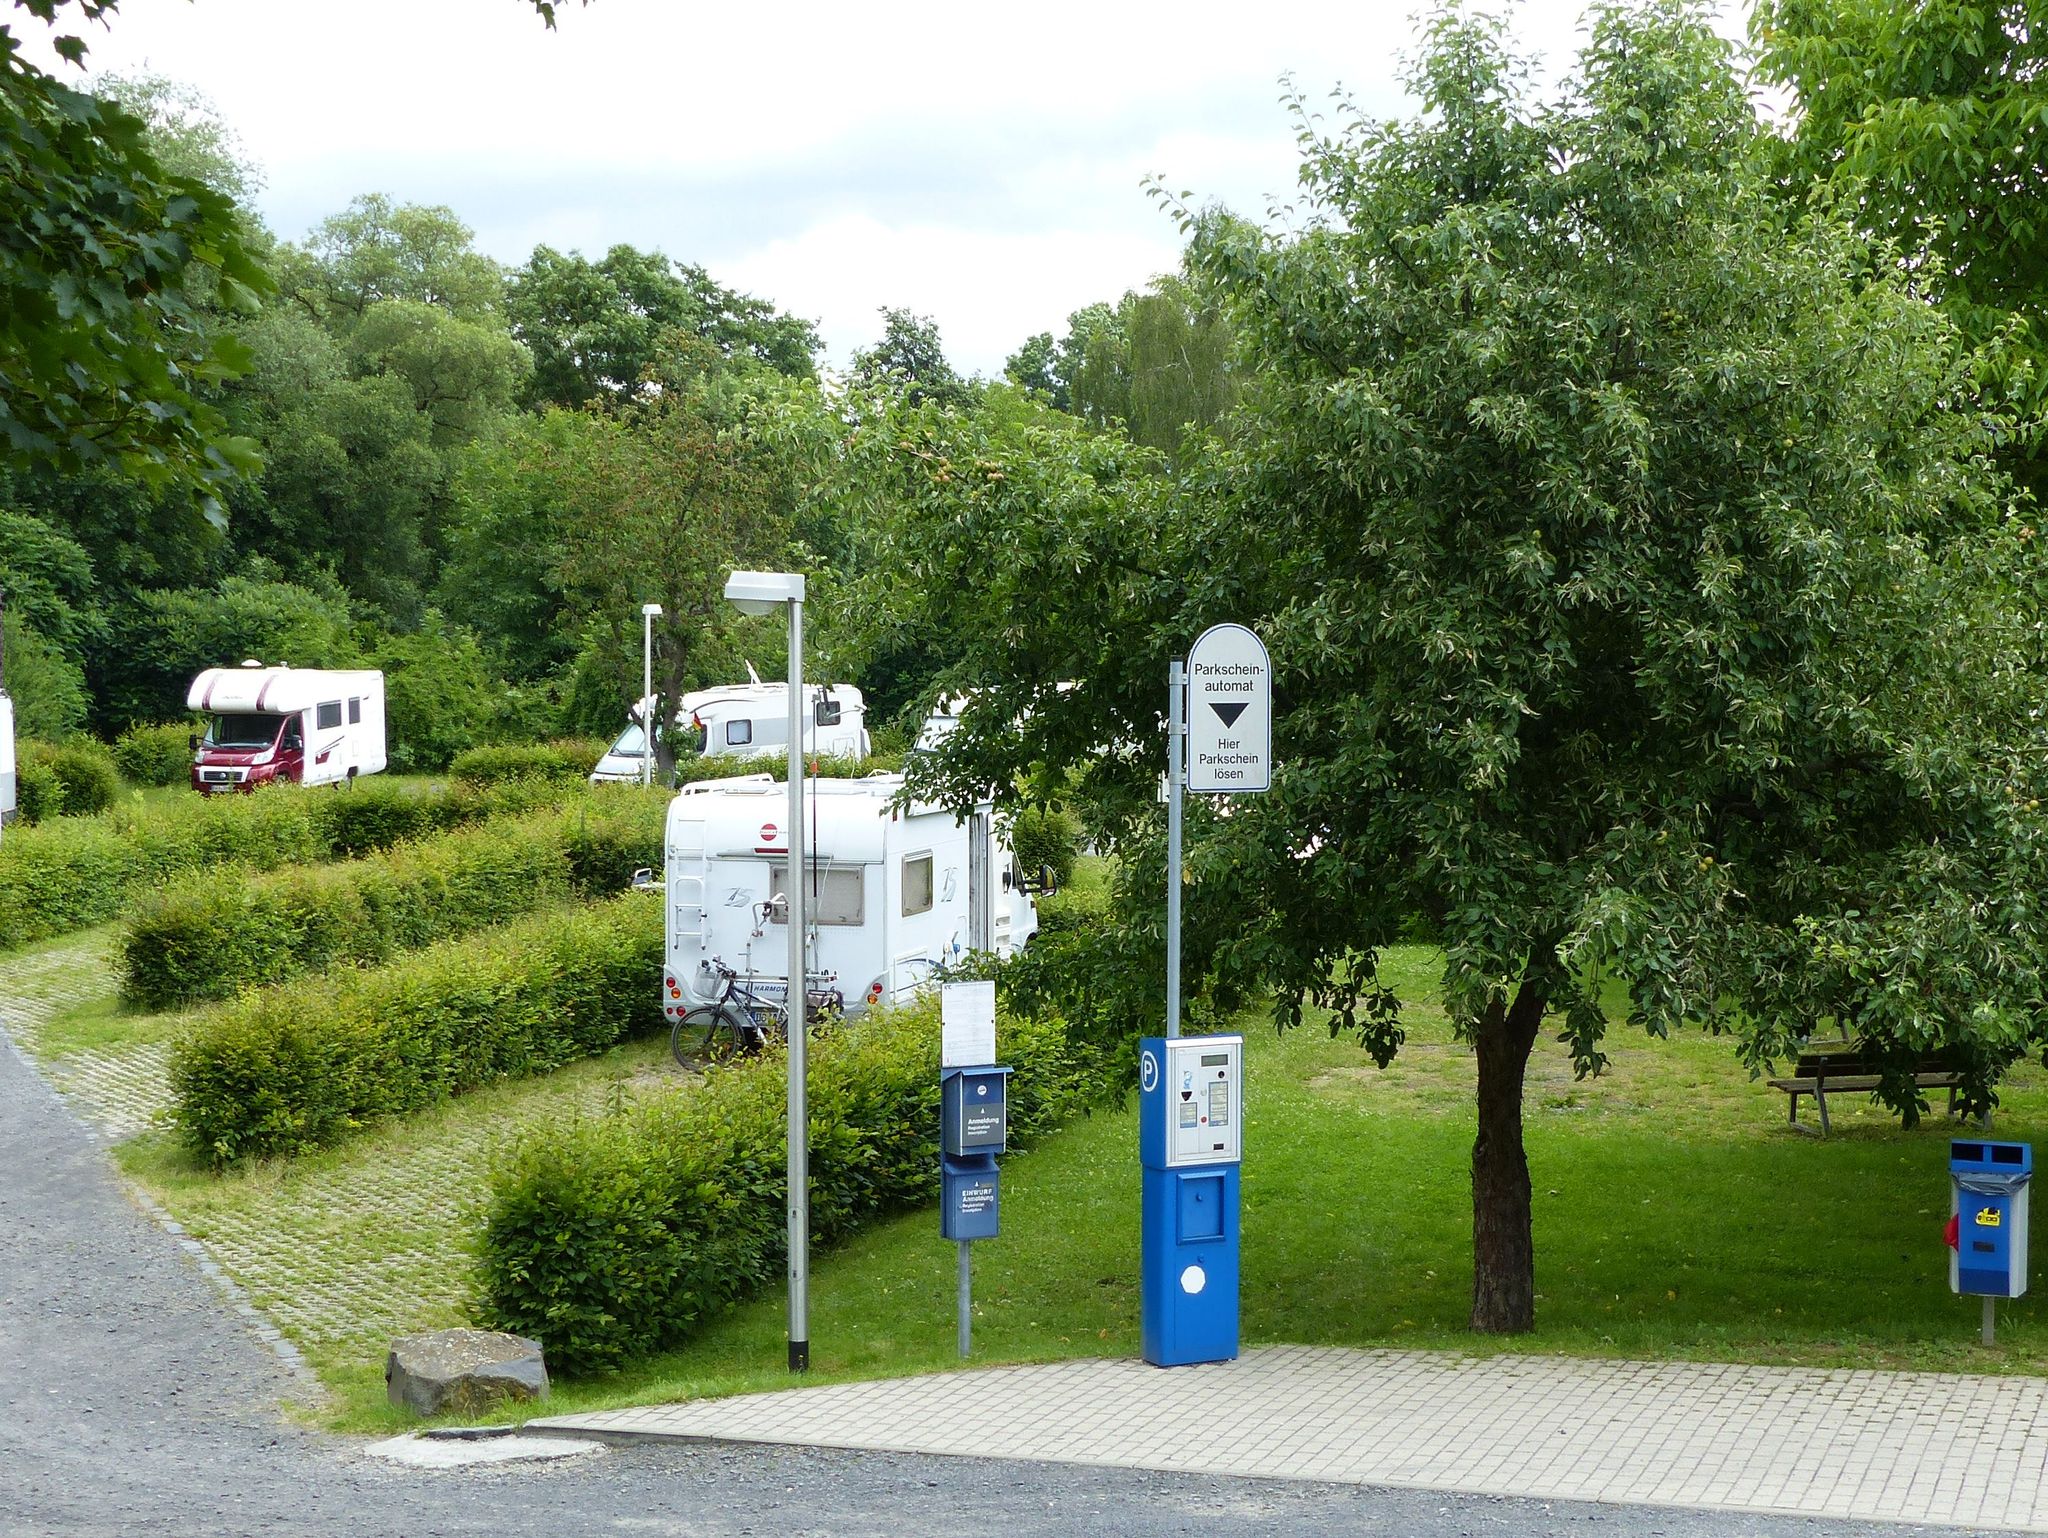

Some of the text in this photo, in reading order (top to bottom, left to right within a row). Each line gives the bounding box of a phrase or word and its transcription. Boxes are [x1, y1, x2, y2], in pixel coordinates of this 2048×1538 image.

[1195, 663, 1264, 675] Parkschein-
[1204, 679, 1254, 692] automat
[1218, 738, 1241, 750] Hier
[1199, 752, 1259, 765] Parkschein
[1214, 767, 1244, 780] lösen
[754, 985, 788, 993] HARMON
